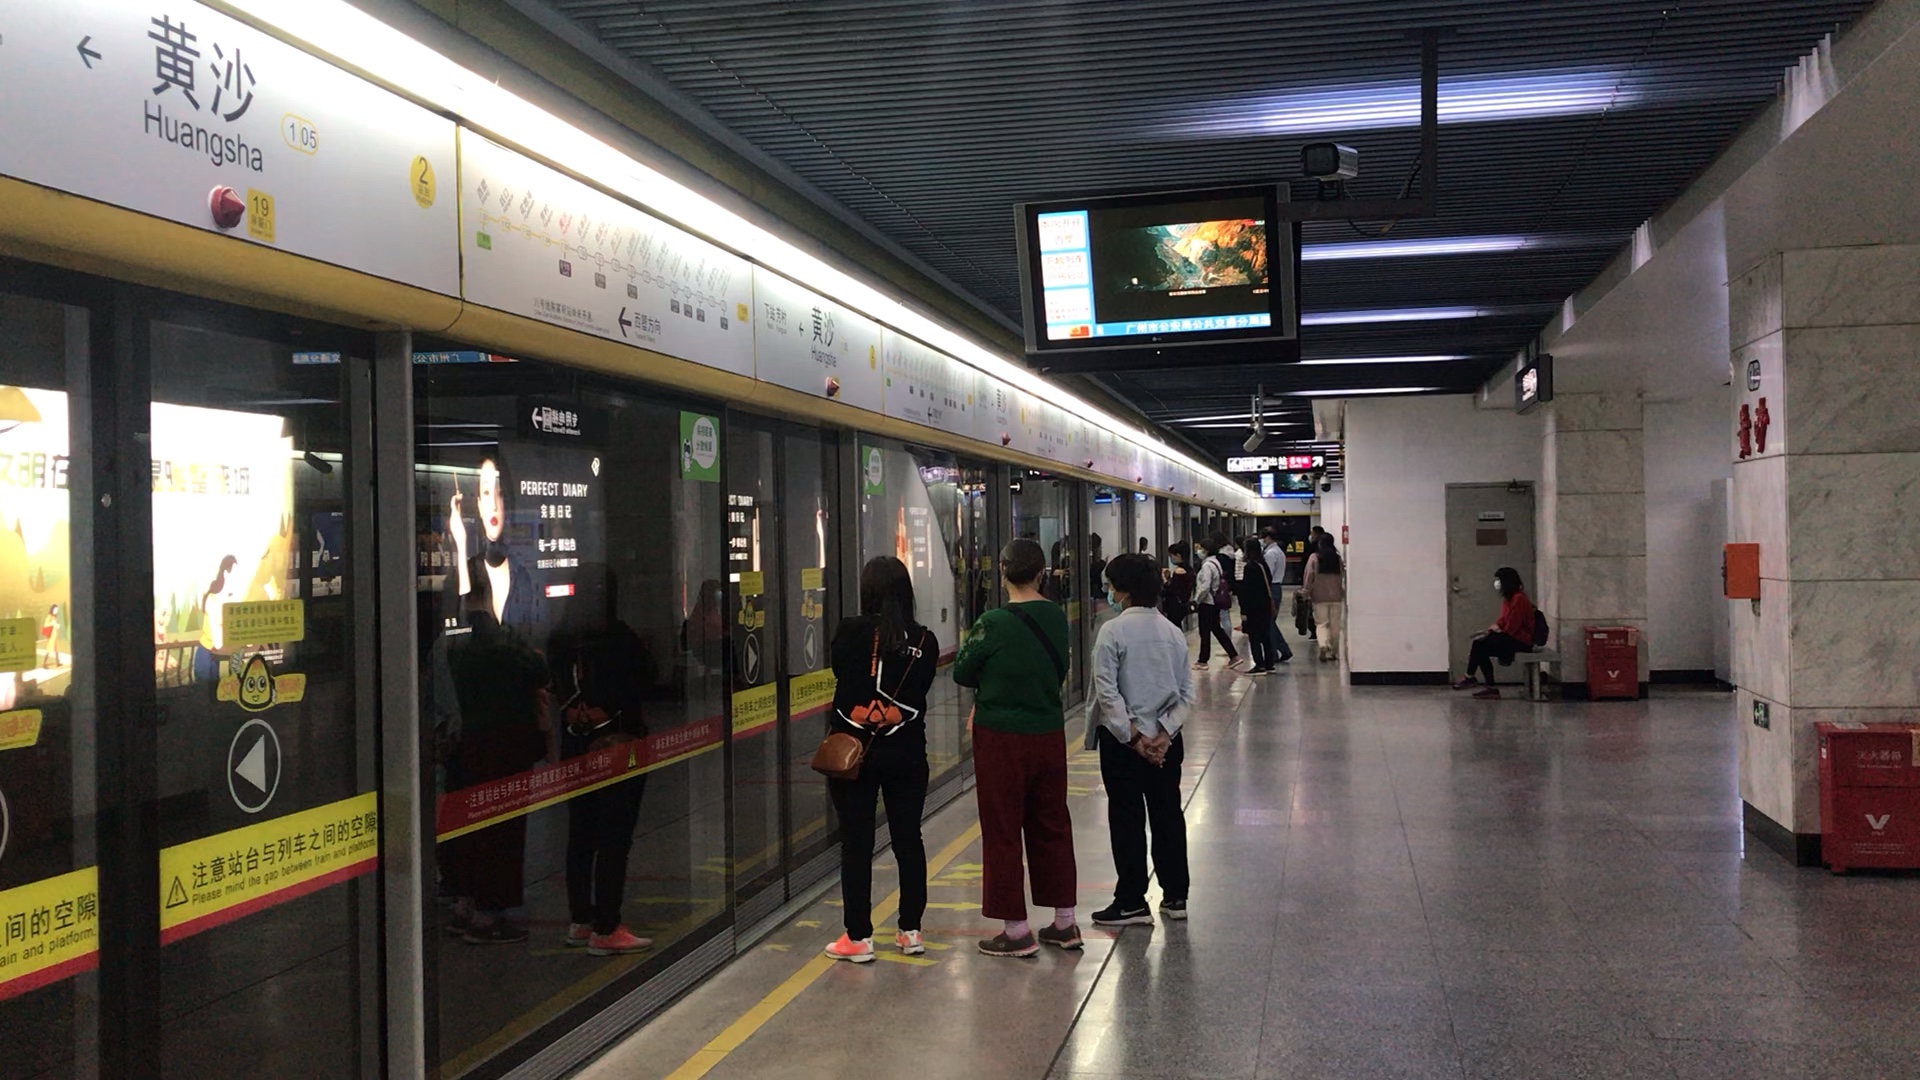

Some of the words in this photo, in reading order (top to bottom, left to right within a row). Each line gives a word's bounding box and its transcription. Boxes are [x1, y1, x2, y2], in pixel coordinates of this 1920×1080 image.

[148, 14, 257, 122] 黄沙
[144, 99, 264, 173] Huangsha
[418, 156, 428, 185] 2
[253, 195, 269, 217] 19
[811, 305, 835, 347] 黄沙
[811, 343, 837, 369] Huangsha
[520, 480, 559, 497] PERFECT
[562, 482, 588, 497] DIARY
[540, 504, 572, 519] 完美日记
[538, 539, 557, 553] 每一步
[192, 811, 377, 890] 注意站台与列车之间的空隙
[192, 888, 222, 905] Please
[225, 880, 245, 895] mind
[249, 874, 261, 888] the
[264, 869, 279, 885] gap
[281, 858, 313, 876] between
[315, 851, 331, 866] train
[333, 846, 346, 859] and
[0, 893, 97, 948] 间的空隙
[23, 941, 44, 960] and
